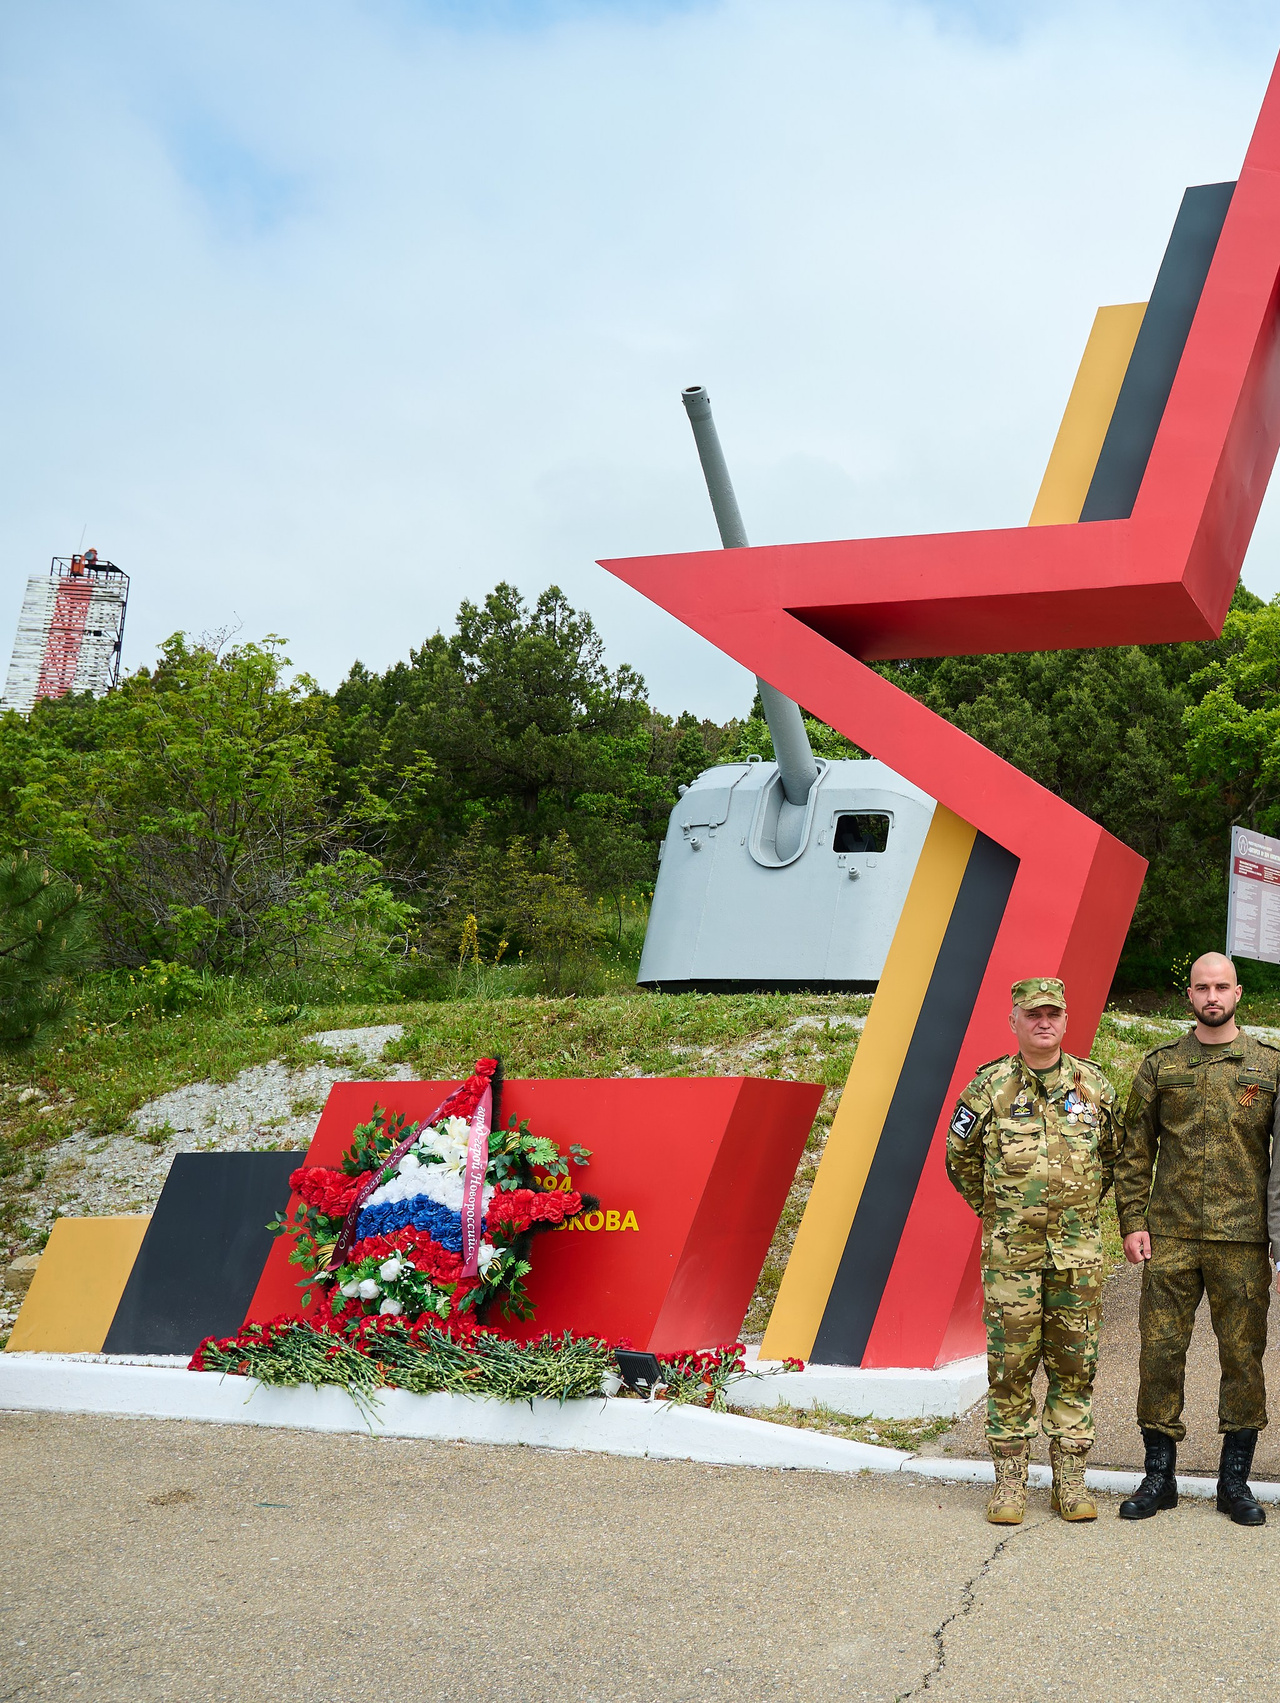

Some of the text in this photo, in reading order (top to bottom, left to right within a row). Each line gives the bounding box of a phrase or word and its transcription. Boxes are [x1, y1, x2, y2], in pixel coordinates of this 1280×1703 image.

[954, 1112, 971, 1132] Z
[464, 1105, 492, 1265] город-герой Новороссийск
[338, 1230, 350, 1250] От
